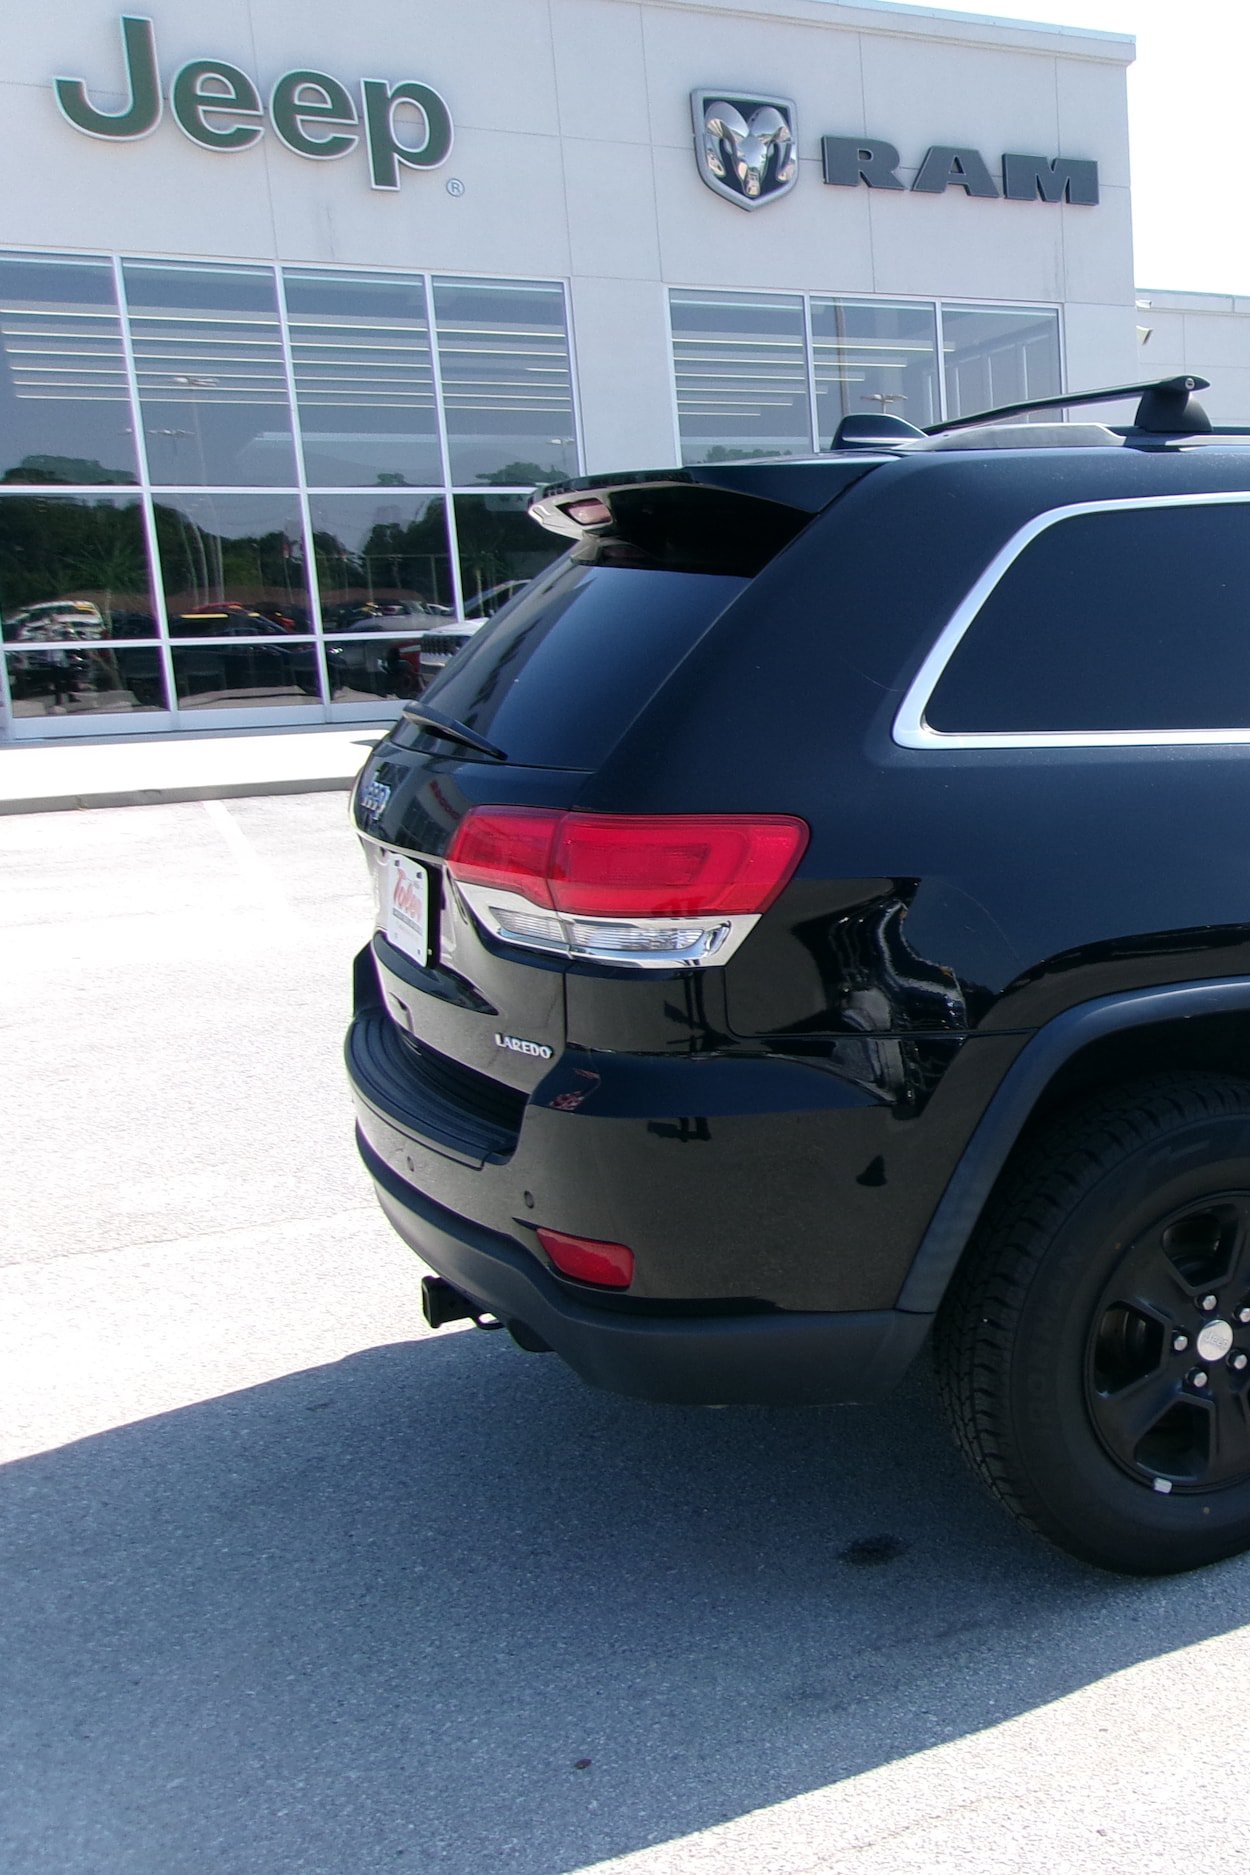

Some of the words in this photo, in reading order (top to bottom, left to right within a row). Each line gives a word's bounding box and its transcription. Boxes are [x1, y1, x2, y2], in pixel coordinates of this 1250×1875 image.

[52, 14, 456, 192] Jeep
[821, 134, 1100, 206] RAM
[494, 1032, 553, 1060] LAREDO
